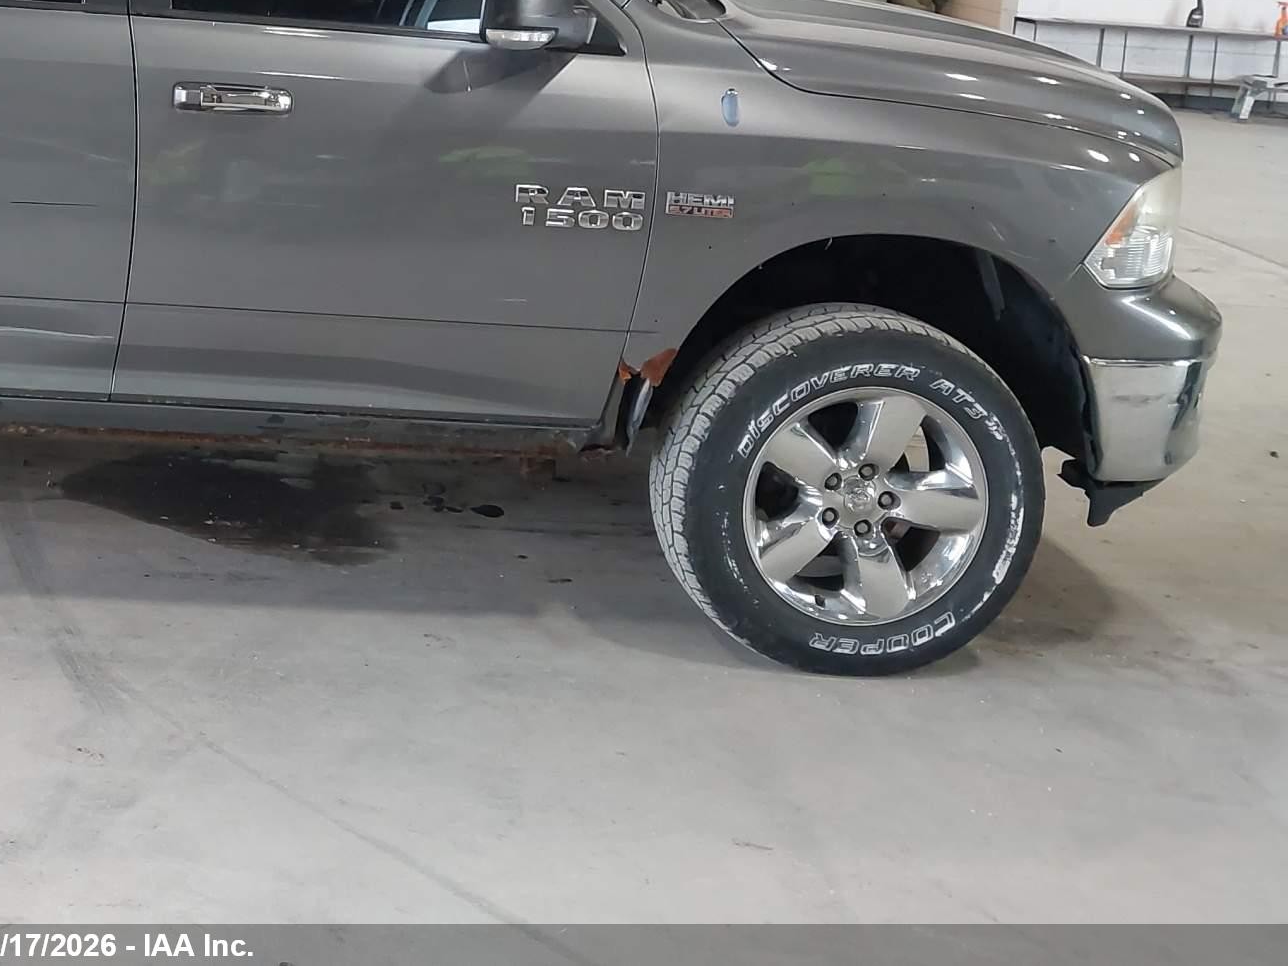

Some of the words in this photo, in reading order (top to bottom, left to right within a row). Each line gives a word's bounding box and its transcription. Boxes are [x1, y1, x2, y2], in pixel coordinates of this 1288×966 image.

[515, 184, 646, 210] RAM
[666, 191, 735, 208] HEMI
[521, 206, 644, 231] 1500
[738, 362, 921, 458] DISCOVERER
[929, 378, 988, 420] AT3
[809, 611, 956, 656] COOPER
